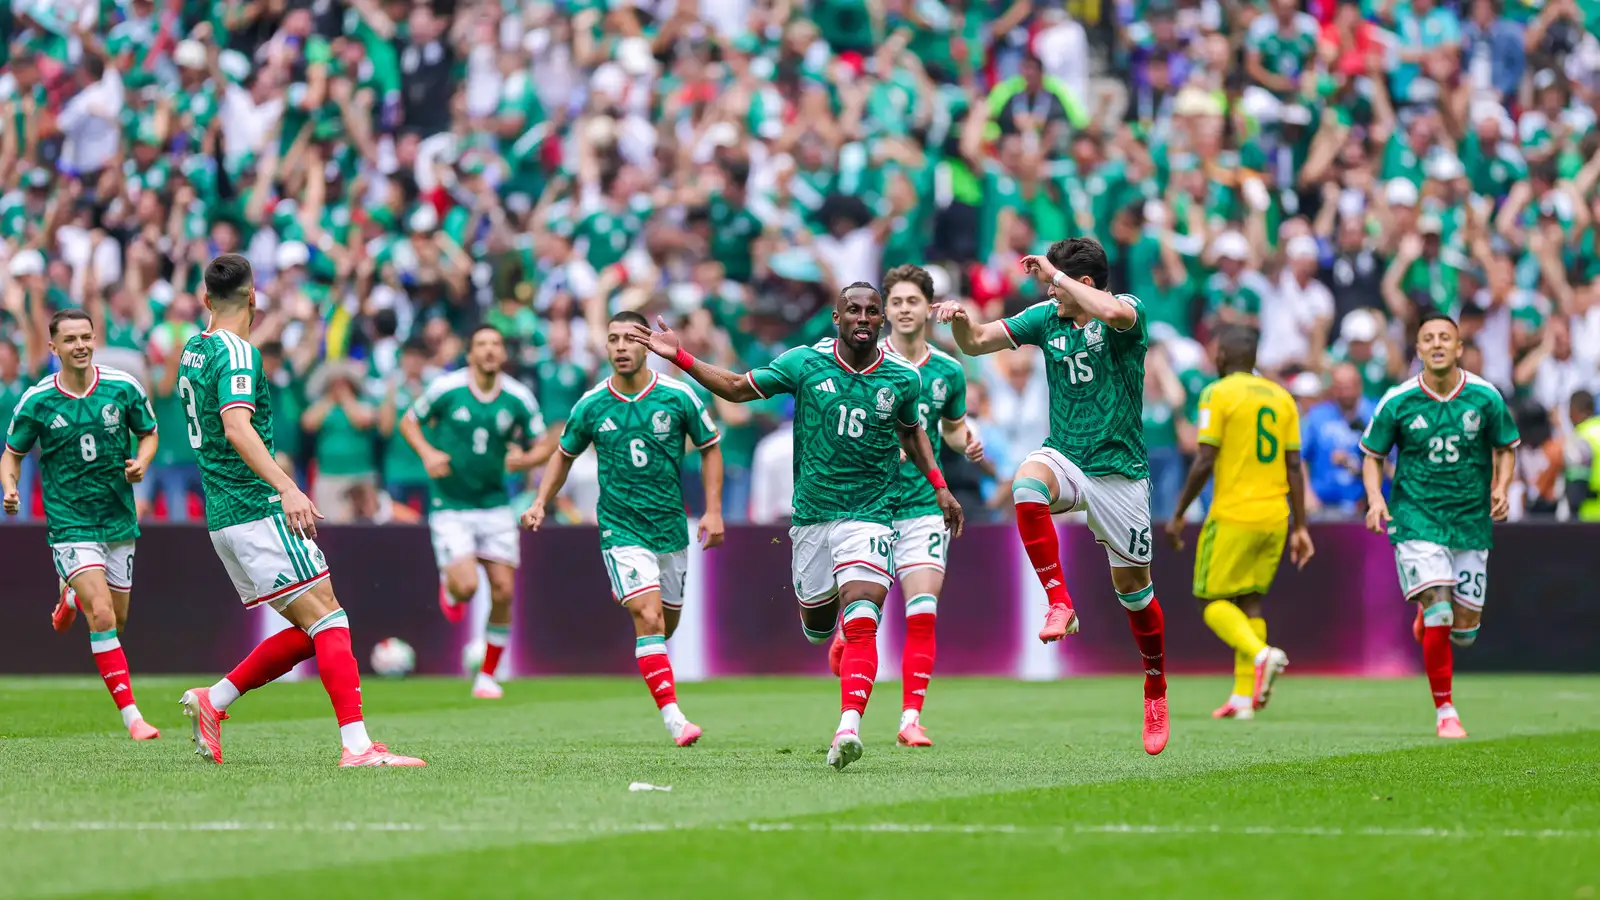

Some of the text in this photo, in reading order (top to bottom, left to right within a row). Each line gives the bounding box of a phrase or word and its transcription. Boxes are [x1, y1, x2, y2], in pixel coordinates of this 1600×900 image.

[1063, 351, 1094, 384] 15
[178, 375, 202, 449] 3
[837, 404, 867, 438] 16
[79, 433, 97, 462] 8
[1257, 406, 1278, 464] 6
[1428, 434, 1460, 463] 25
[630, 438, 648, 467] 6
[1129, 527, 1149, 556] 15
[1457, 570, 1484, 598] 25
